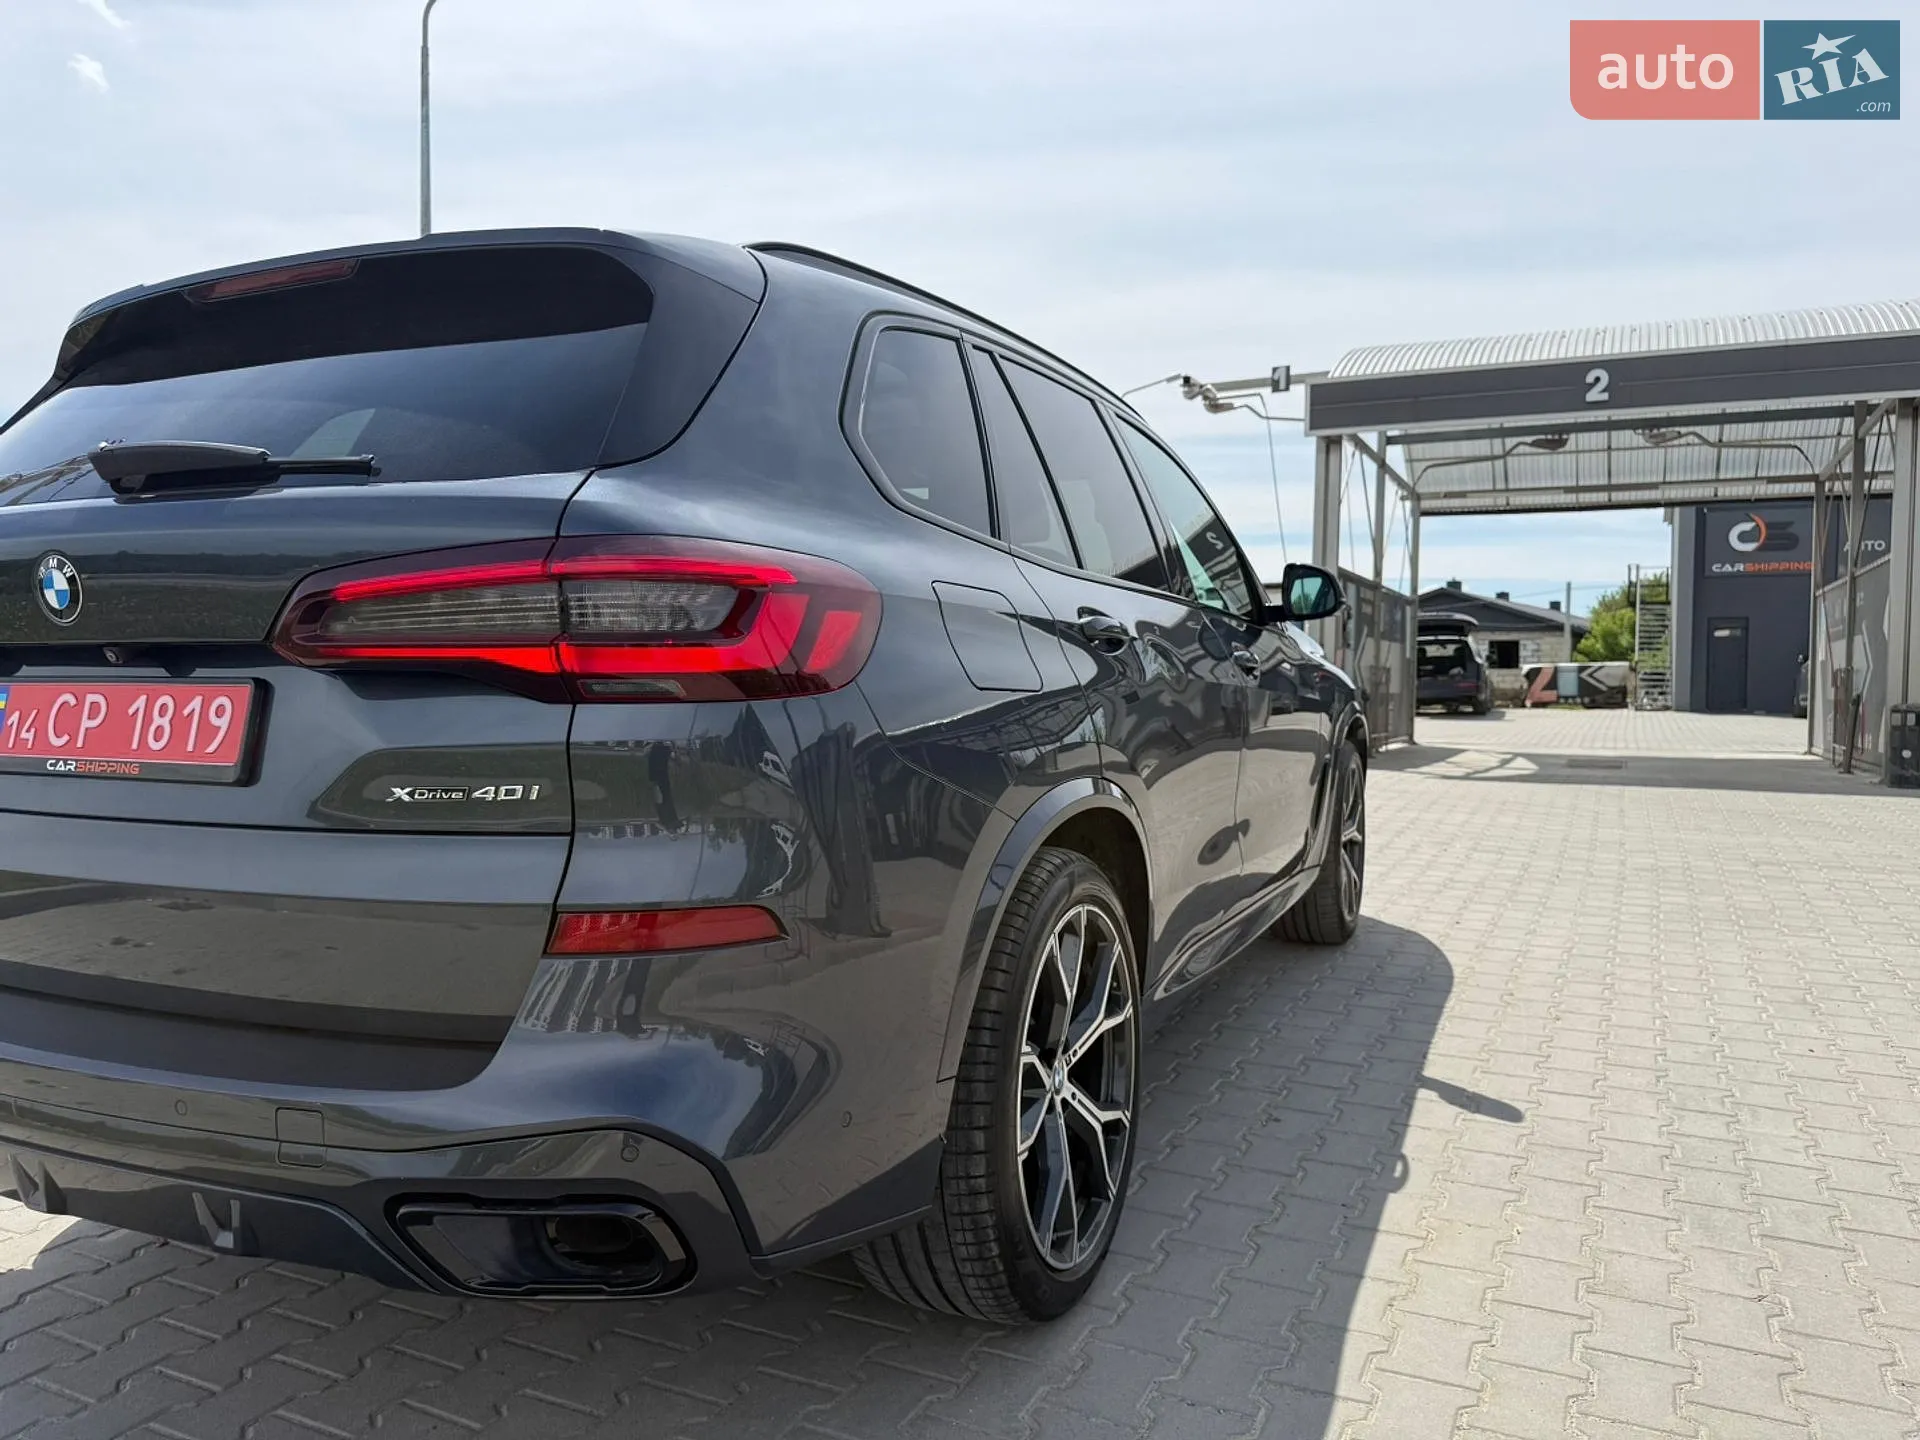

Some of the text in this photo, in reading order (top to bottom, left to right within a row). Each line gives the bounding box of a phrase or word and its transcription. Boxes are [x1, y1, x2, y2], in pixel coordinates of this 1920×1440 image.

[1273, 367, 1287, 390] 1
[1585, 368, 1609, 402] 2
[1843, 540, 1886, 552] ATO
[38, 557, 74, 578] BMW
[6, 692, 233, 754] 14 CP 1819
[46, 759, 140, 775] CARSHIPPING
